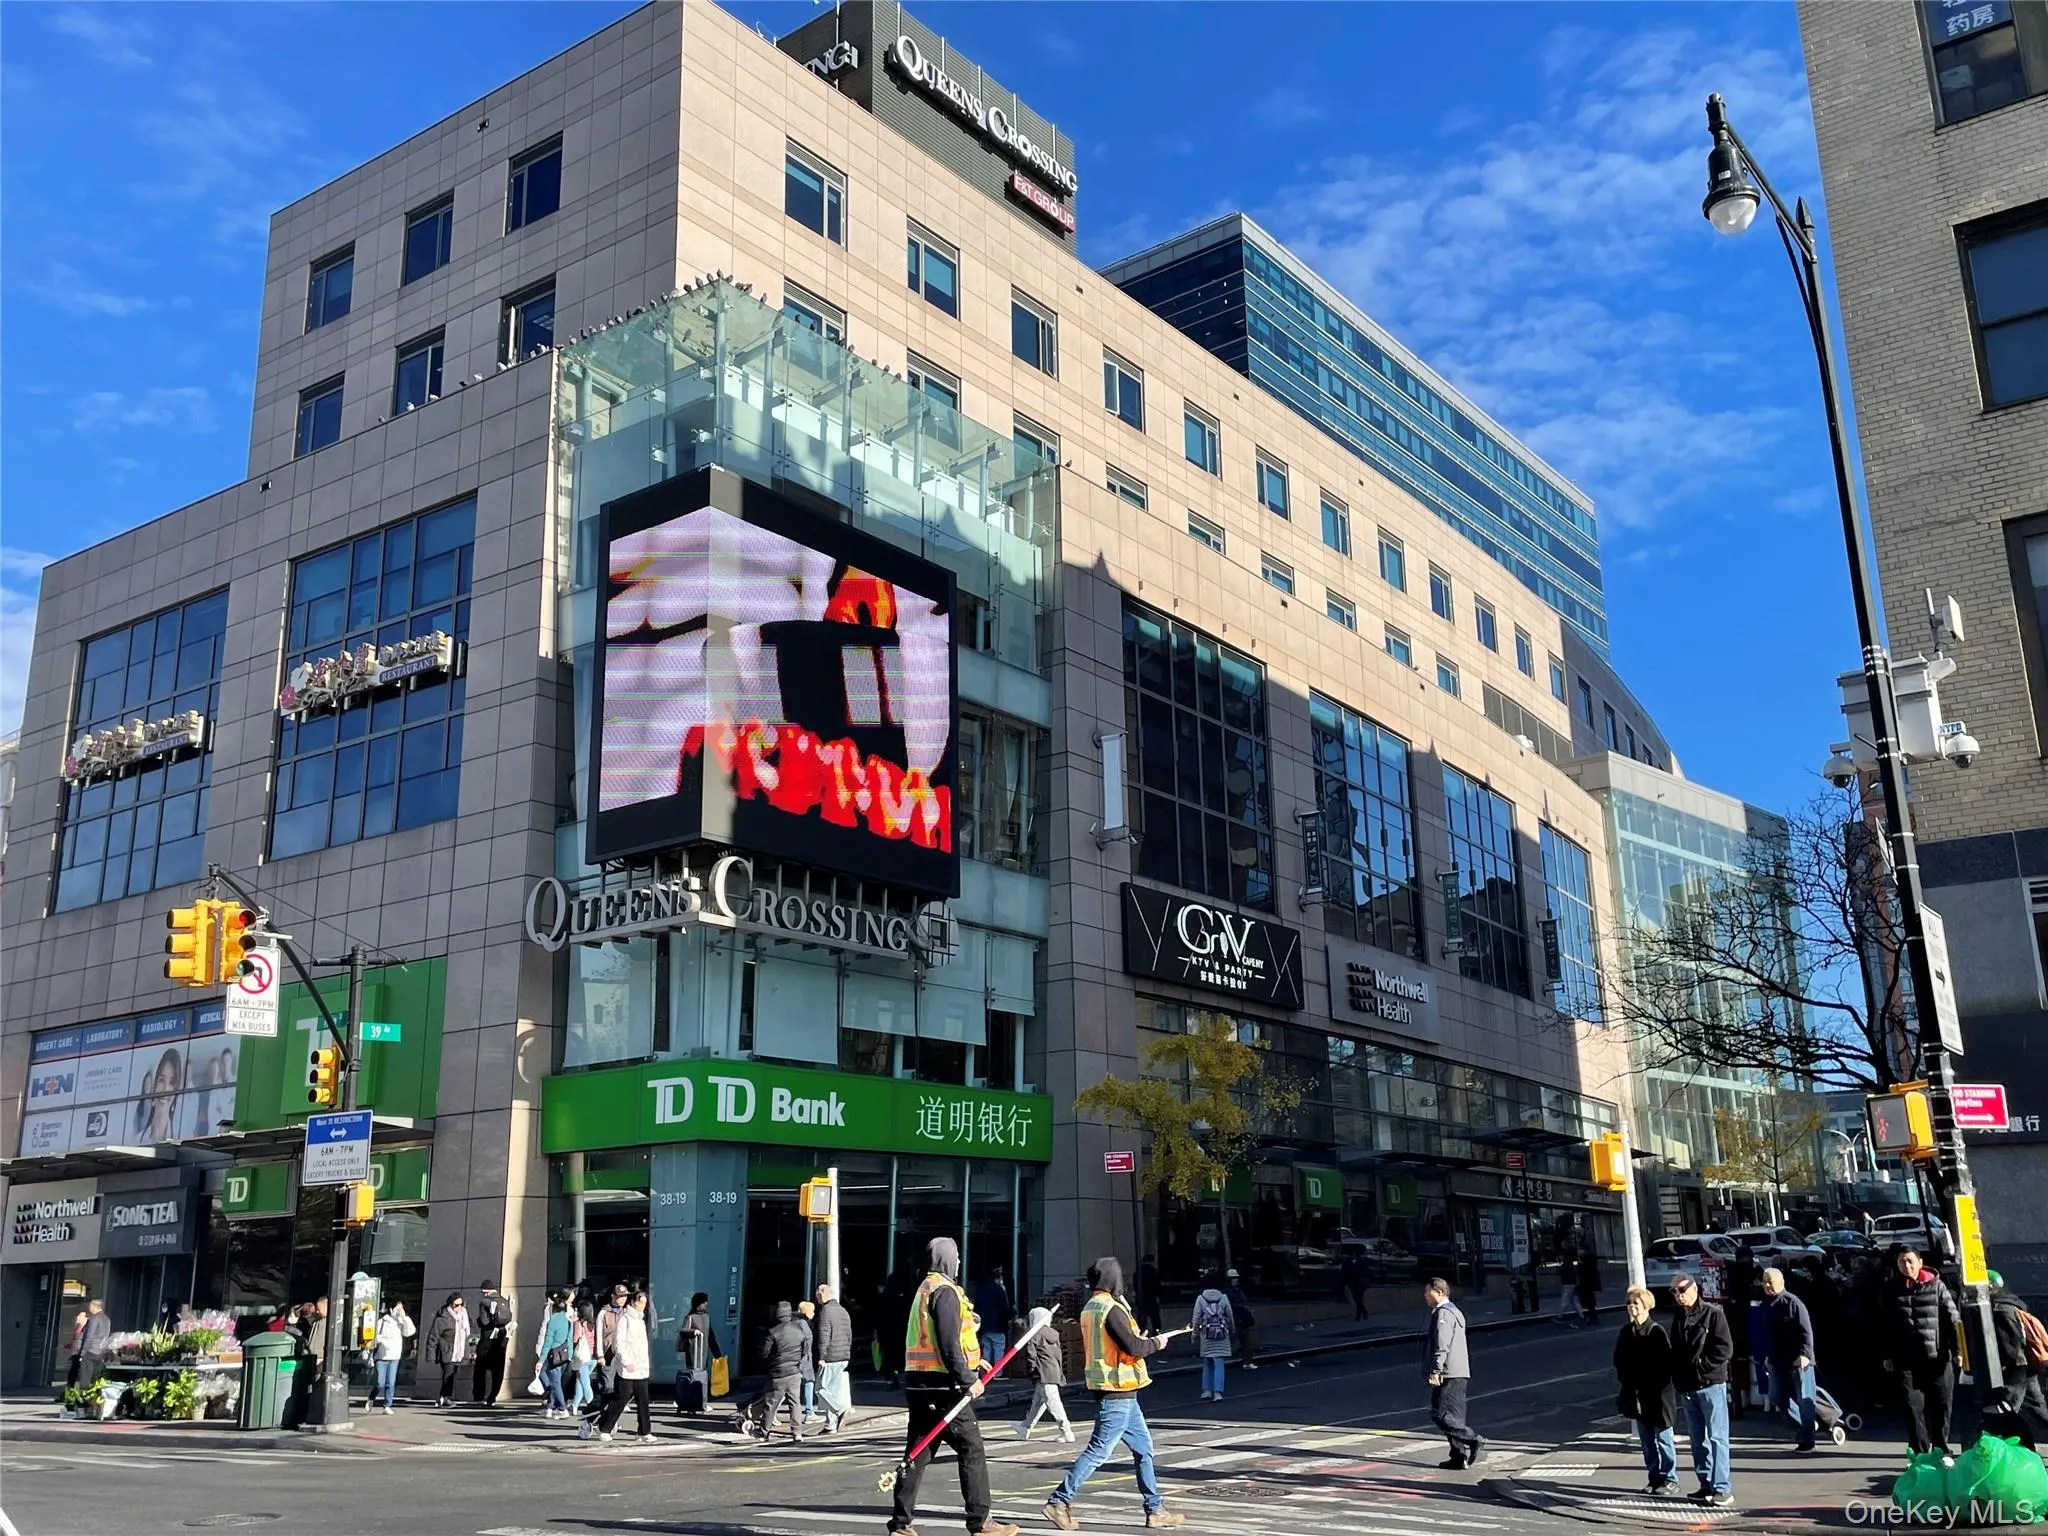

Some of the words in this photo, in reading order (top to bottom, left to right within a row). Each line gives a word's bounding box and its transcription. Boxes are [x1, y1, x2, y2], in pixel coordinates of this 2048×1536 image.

[1946, 4, 1995, 36] 药房
[1034, 189, 1075, 227] GROUP
[381, 656, 437, 683] RESTAURANT
[1192, 956, 1210, 968] KTV
[1224, 964, 1253, 979] PARTY
[1375, 968, 1430, 1003] Northwell
[257, 999, 274, 1009] 7PM
[1377, 997, 1413, 1025] Health
[141, 1018, 177, 1034] RADIOLOGY
[239, 1011, 265, 1020] EXCEPT
[86, 1029, 123, 1044] LABORATORY
[232, 1022, 246, 1031] MTA
[249, 1022, 272, 1032] BUSES
[371, 1024, 381, 1039] 39
[58, 1036, 73, 1048] CARE
[647, 1076, 693, 1124] TD
[708, 1075, 755, 1123] TD
[771, 1087, 846, 1127] Bank
[916, 1095, 1032, 1148] 道明银行
[320, 1145, 334, 1156] 6AM
[340, 1145, 354, 1155] 7PM
[227, 1177, 249, 1203] TD
[660, 1191, 687, 1206] 38-19
[709, 1190, 737, 1205] 38-19
[1307, 1177, 1322, 1199] TD
[35, 1196, 95, 1219] Northwell
[112, 1204, 149, 1228] SONG
[152, 1201, 179, 1226] TEA
[32, 1222, 70, 1243] Health
